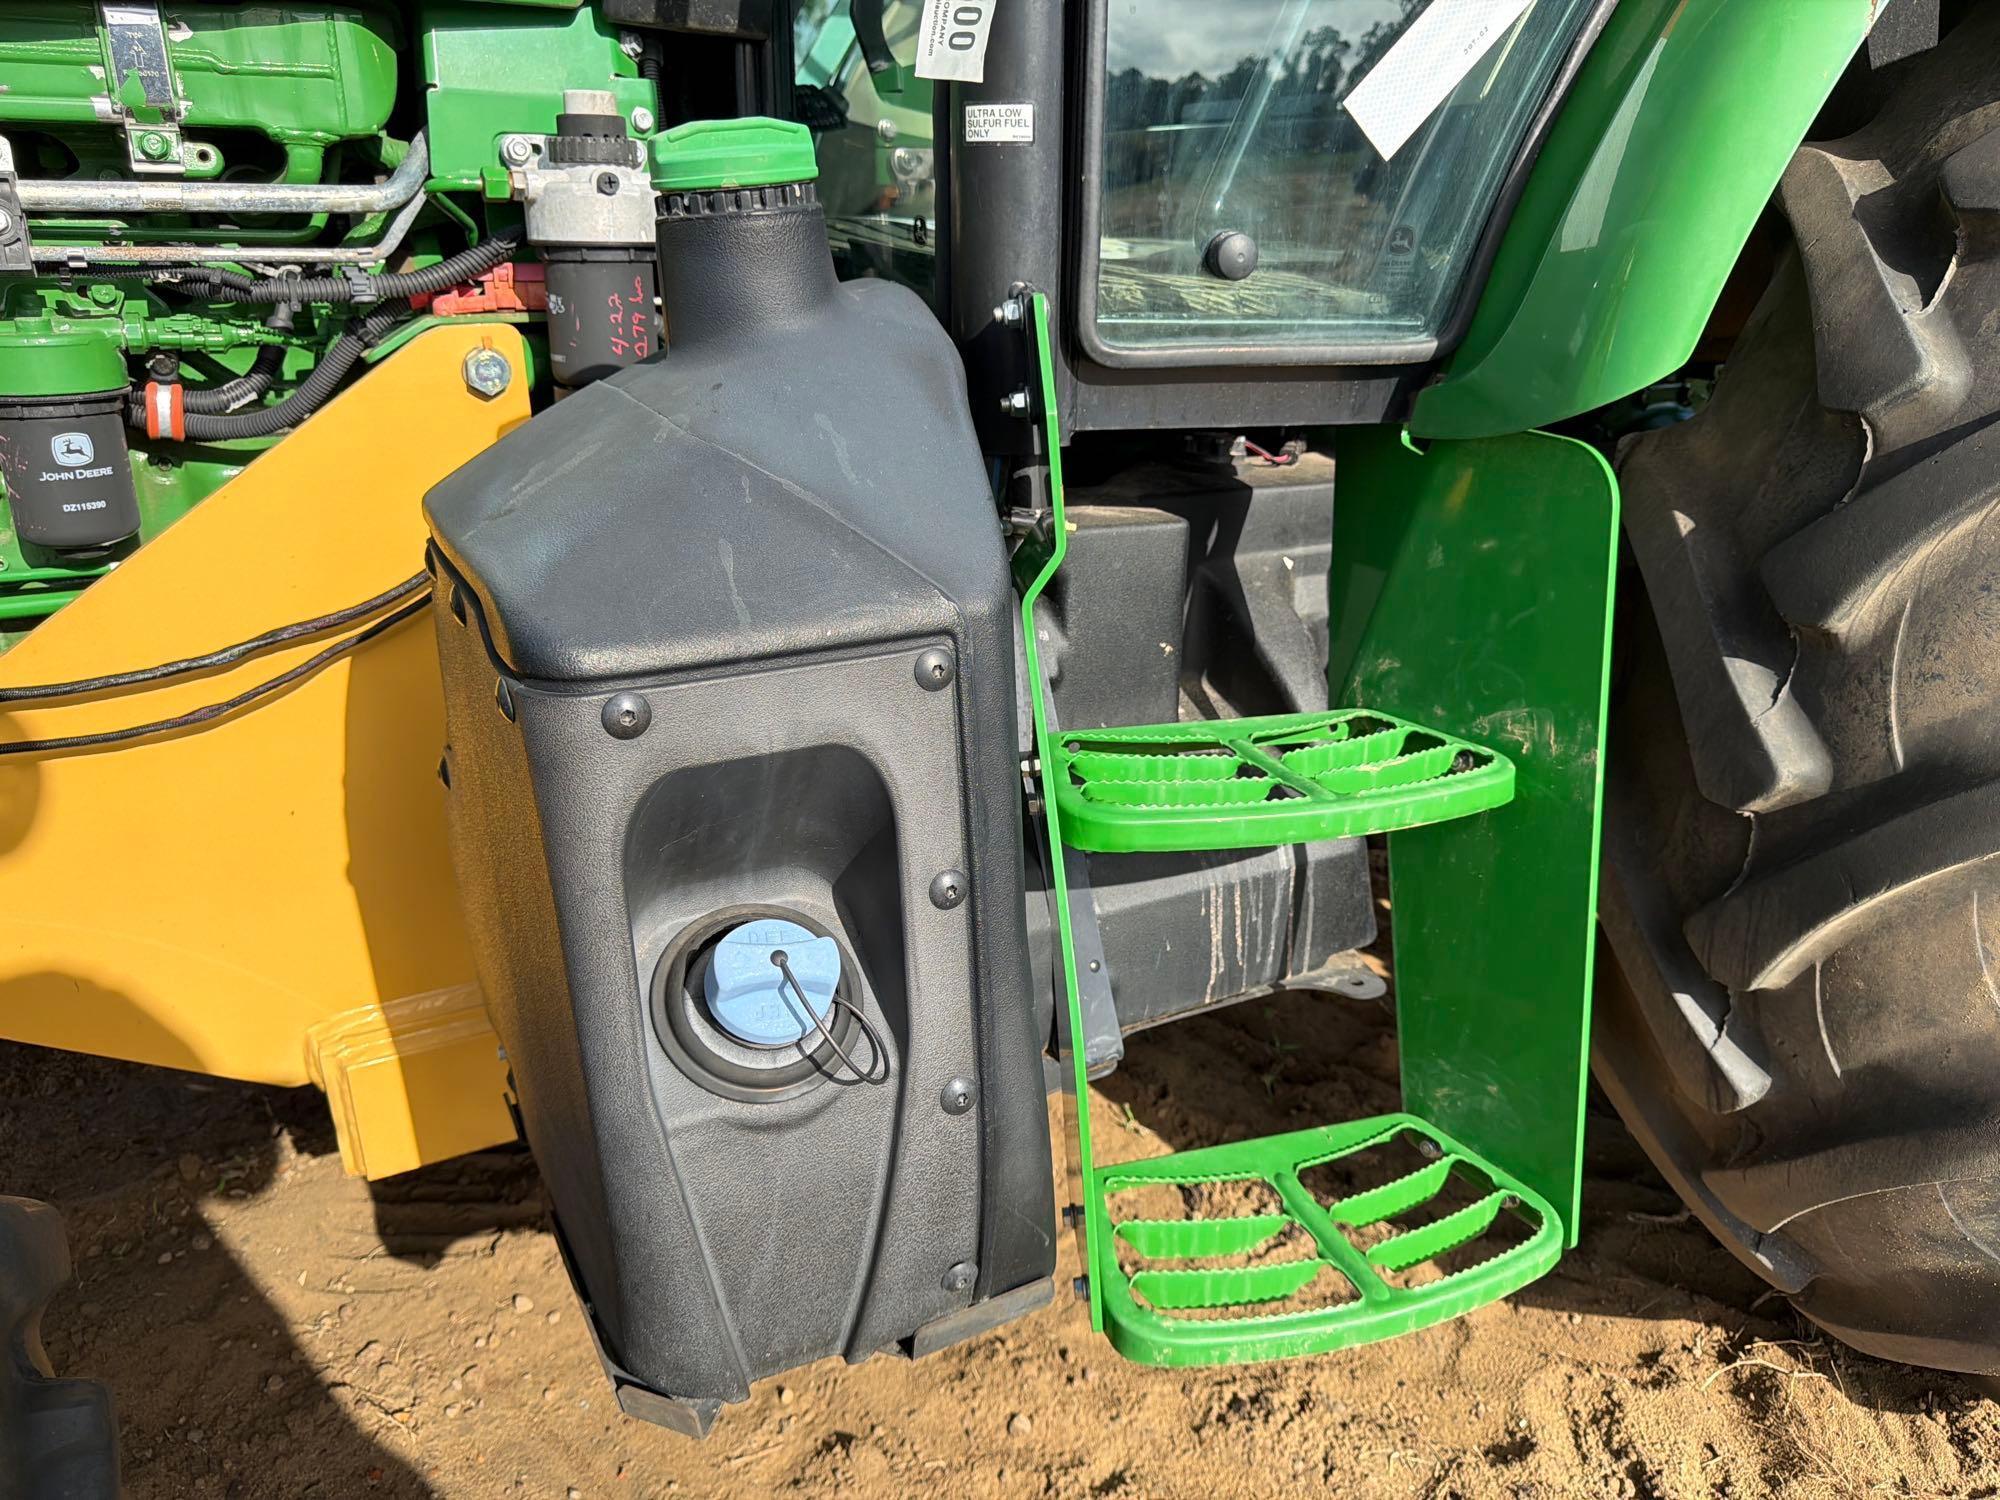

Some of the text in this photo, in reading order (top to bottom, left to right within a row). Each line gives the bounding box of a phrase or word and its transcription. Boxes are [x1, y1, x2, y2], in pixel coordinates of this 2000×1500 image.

[938, 0, 950, 46] OMPANY
[948, 0, 983, 51] 00
[967, 108, 1022, 119] ULTRA LOW
[967, 118, 1030, 129] SULFUR FUEL
[967, 129, 990, 139] ONLY
[39, 466, 114, 482] JOHN DEERE
[62, 500, 107, 513] DZ115390
